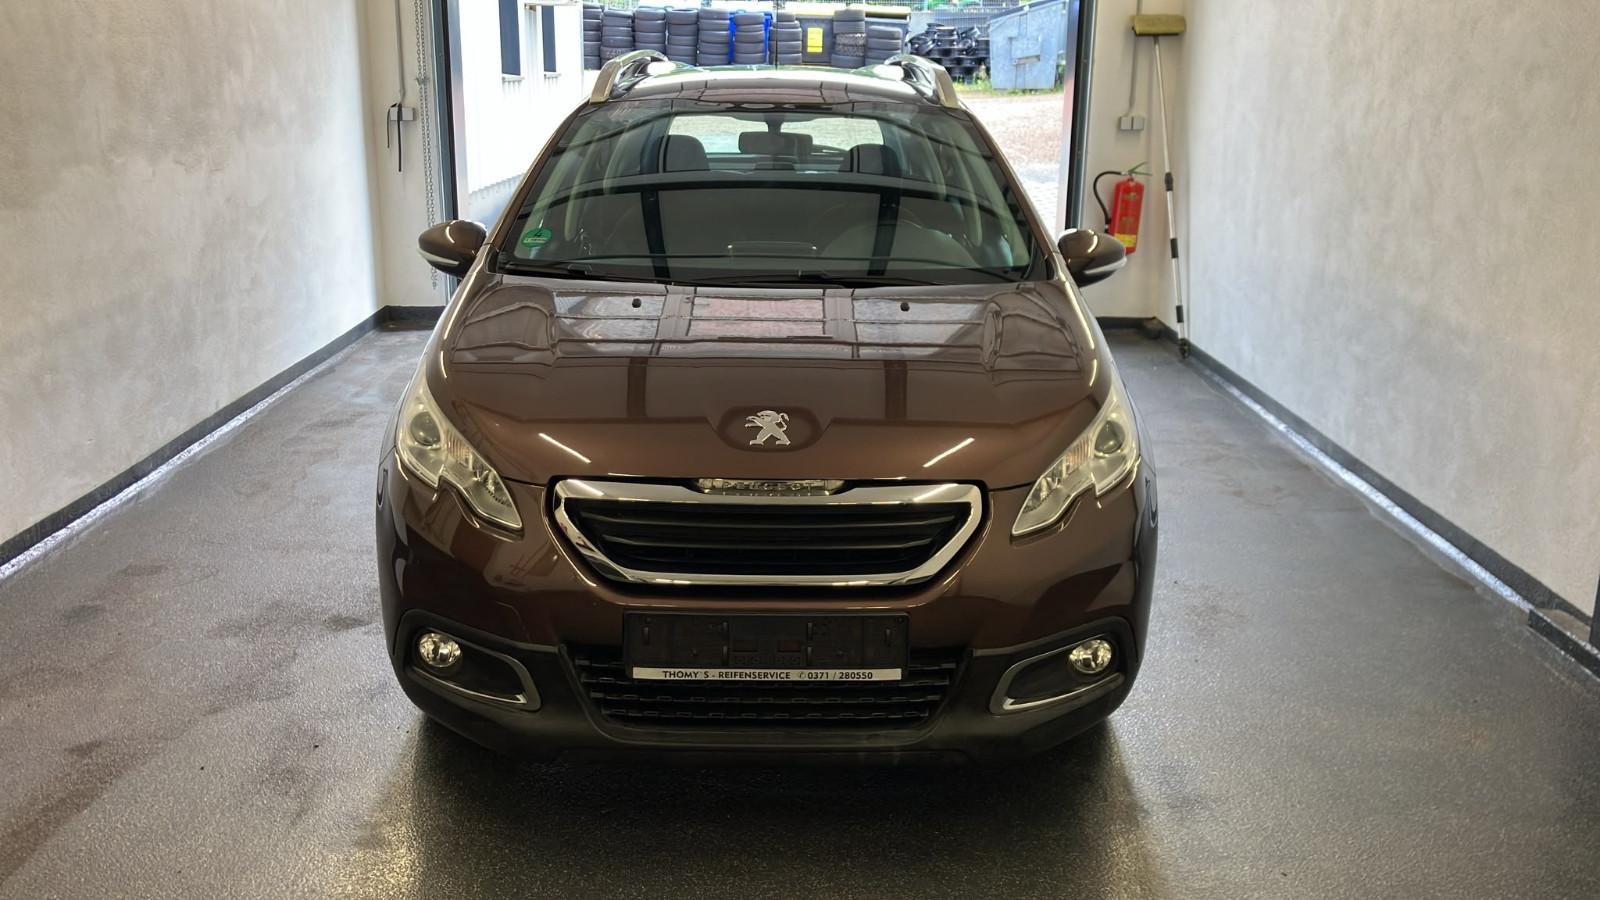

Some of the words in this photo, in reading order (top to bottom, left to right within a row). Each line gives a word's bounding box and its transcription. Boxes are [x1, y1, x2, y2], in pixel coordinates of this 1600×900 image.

[718, 671, 791, 680] REIFENSERVICE
[807, 671, 829, 680] 0371
[839, 671, 873, 680] 280550
